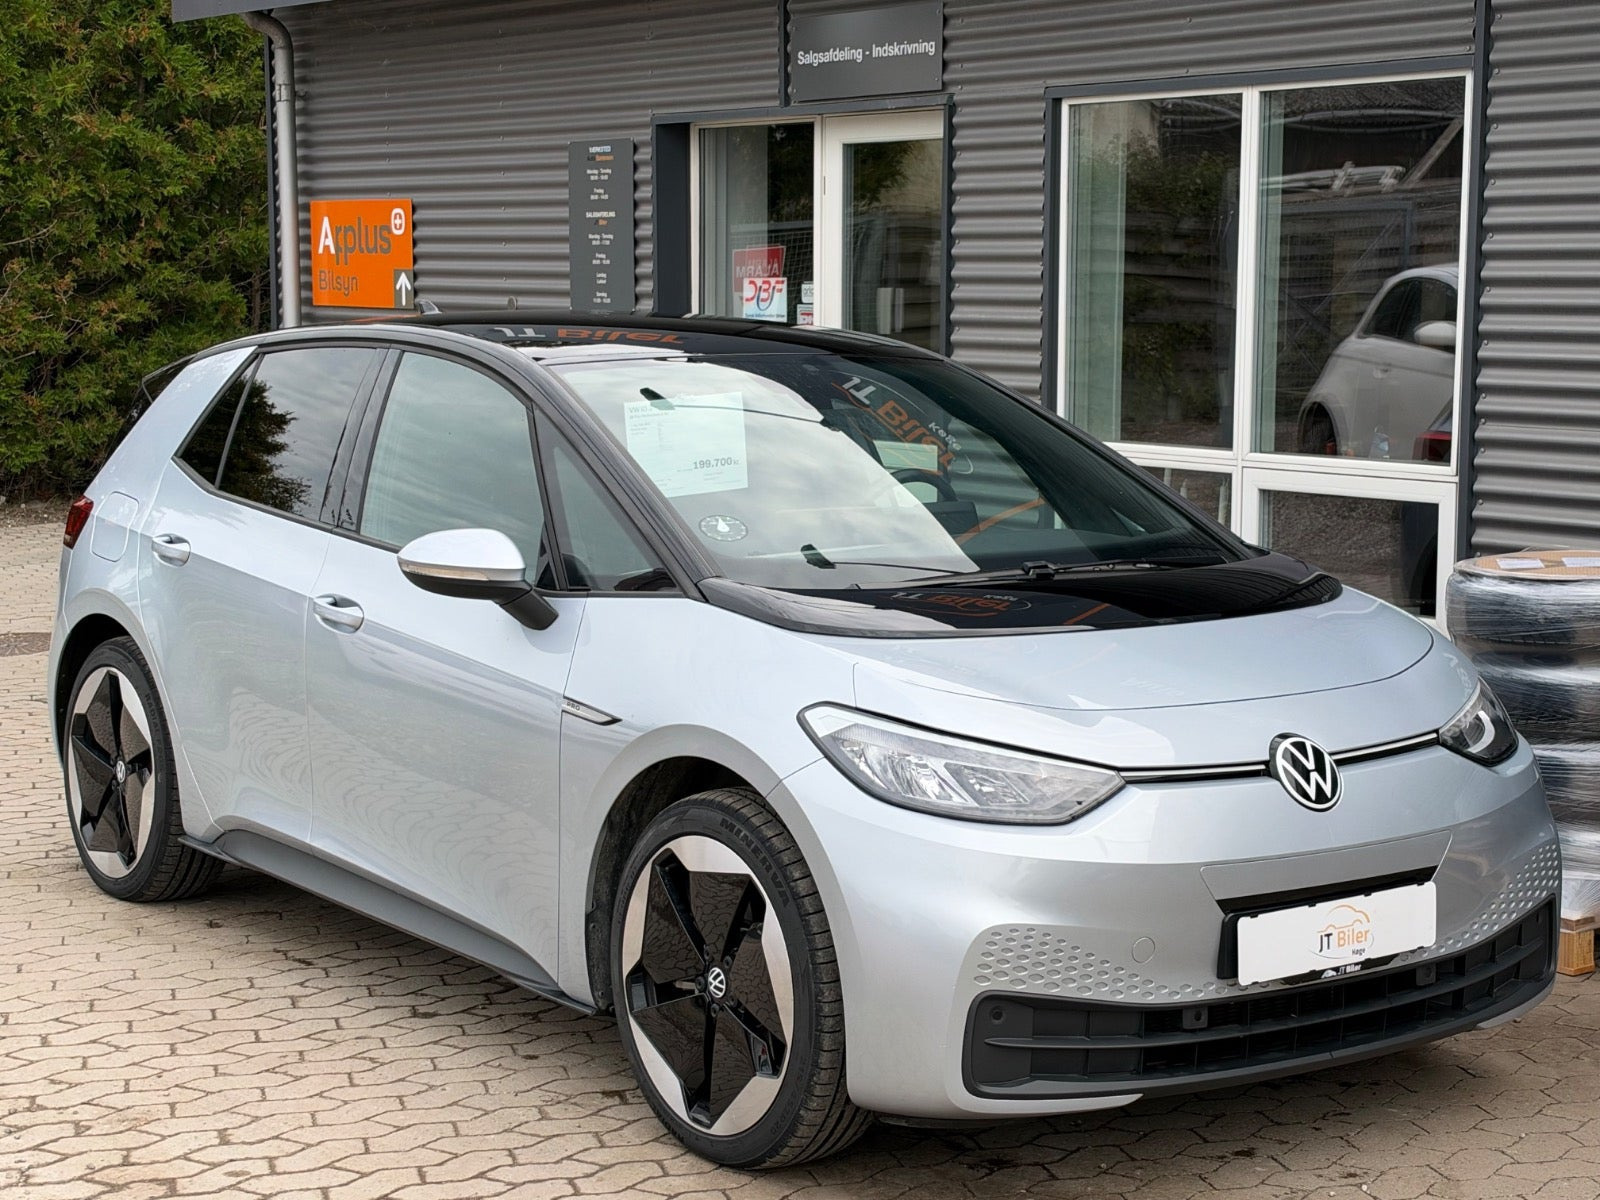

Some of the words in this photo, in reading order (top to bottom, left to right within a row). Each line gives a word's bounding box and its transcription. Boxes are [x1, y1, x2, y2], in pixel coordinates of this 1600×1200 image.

[797, 46, 863, 67] Salgsafdeling
[872, 39, 936, 56] Indskrivning
[318, 270, 359, 297] Bilsyn
[693, 457, 733, 470] 199.700
[720, 817, 791, 908] MINERVA
[1318, 932, 1333, 953] JT
[1337, 928, 1370, 948] Biler
[1346, 964, 1362, 974] Biler
